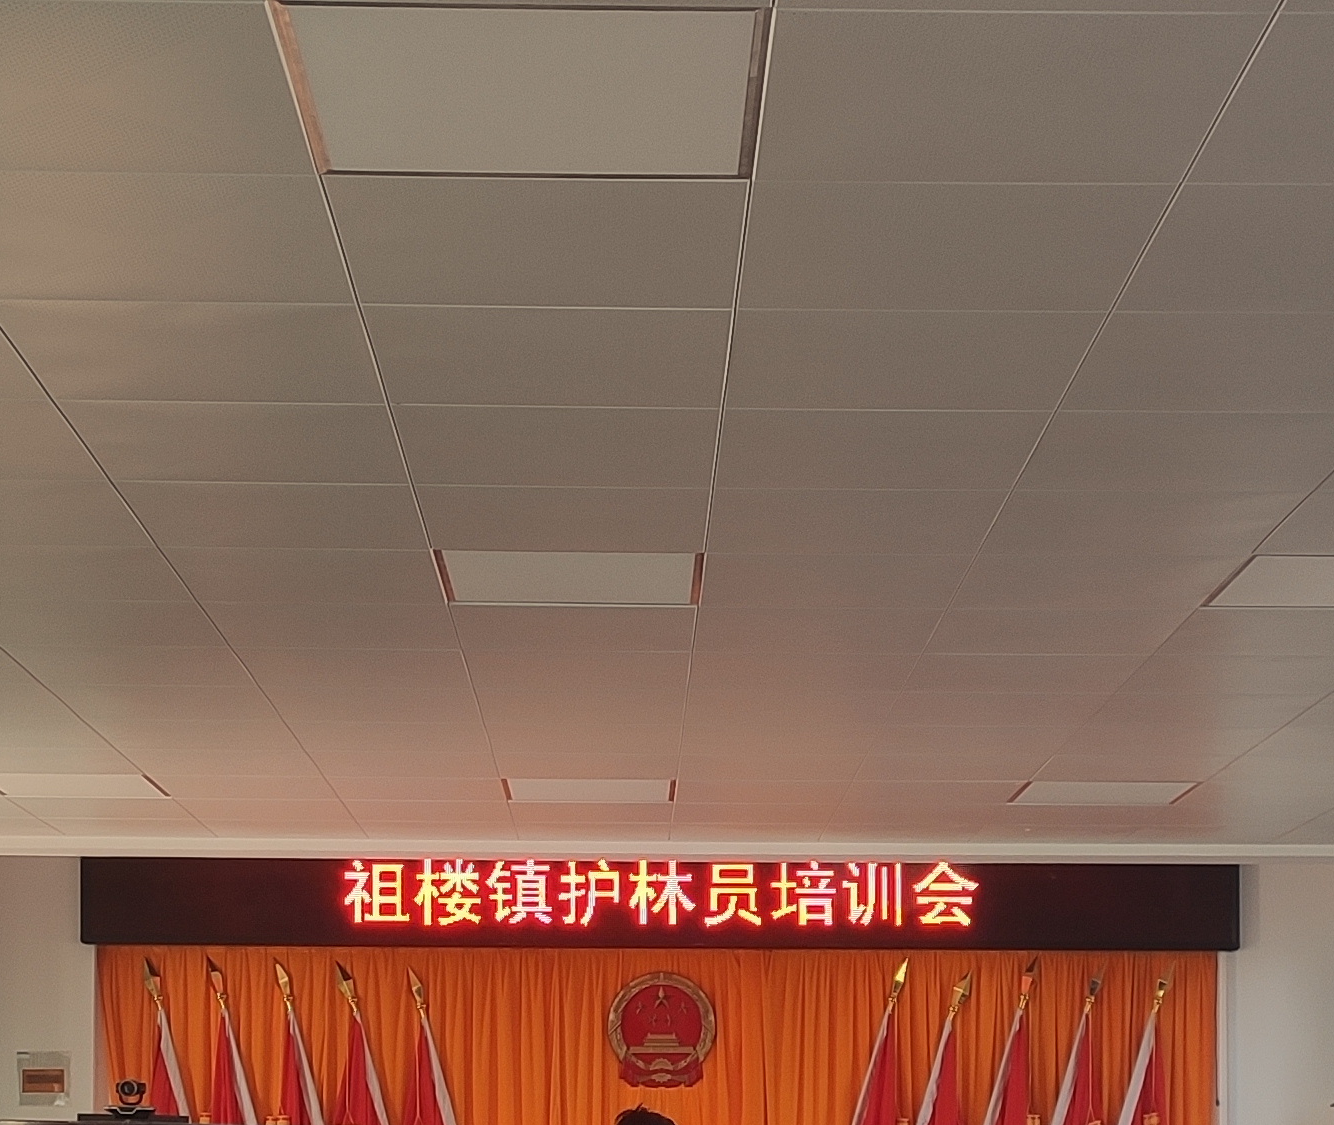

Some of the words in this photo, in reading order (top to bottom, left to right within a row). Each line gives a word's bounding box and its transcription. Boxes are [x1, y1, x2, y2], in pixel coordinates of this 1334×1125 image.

[343, 860, 979, 926] 祖楼镇护林员培训会
